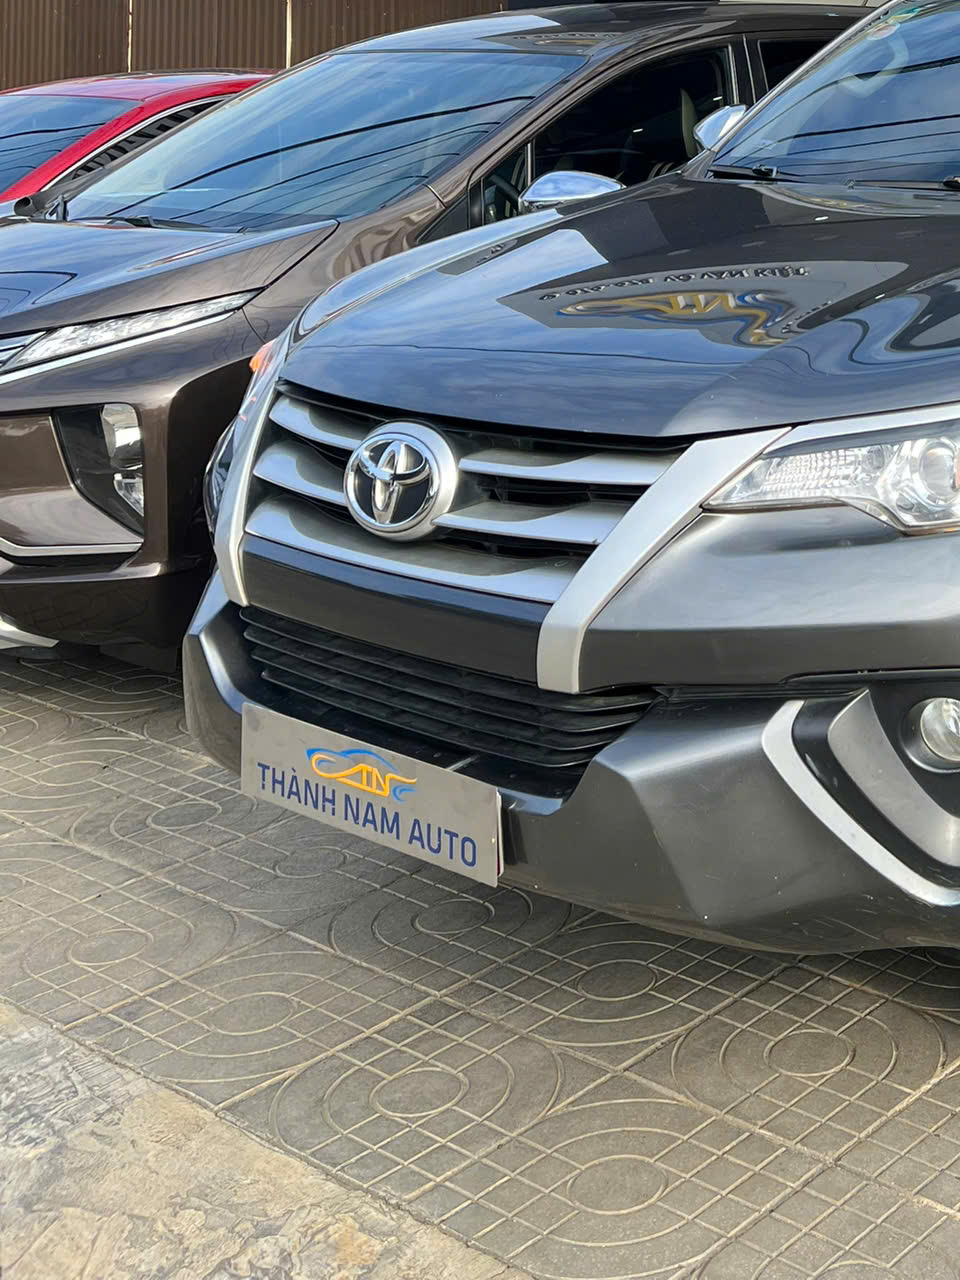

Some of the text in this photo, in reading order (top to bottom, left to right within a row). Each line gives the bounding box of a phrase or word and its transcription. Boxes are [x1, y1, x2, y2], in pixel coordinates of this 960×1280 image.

[256, 761, 478, 868] THÀNH NAM AUTO
